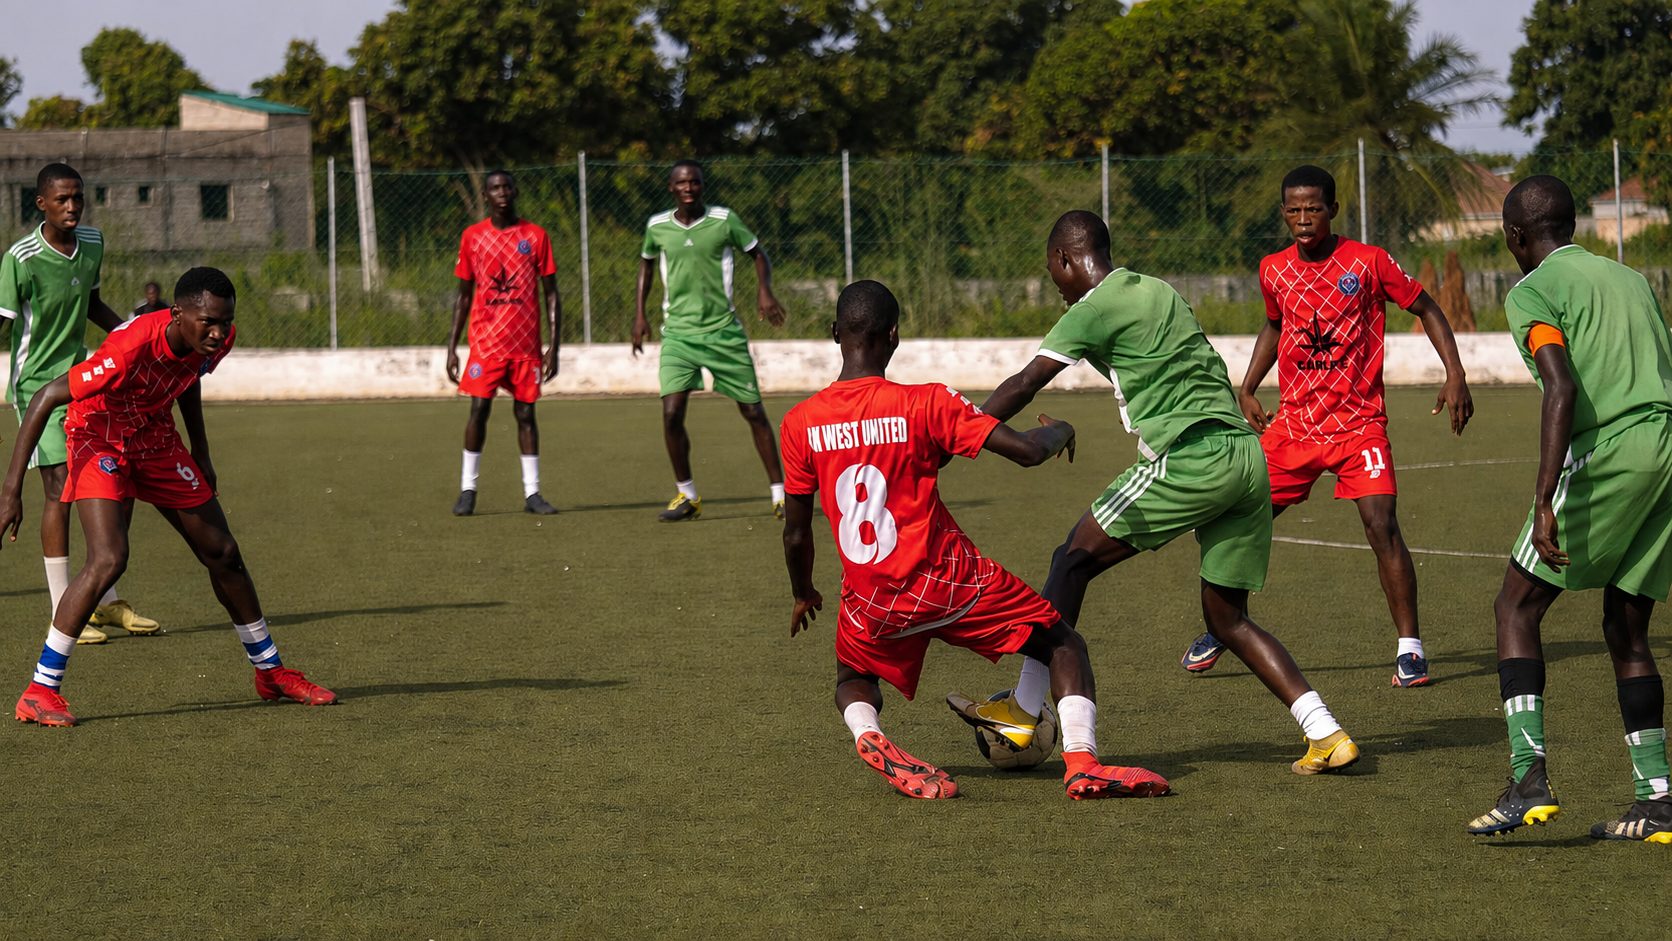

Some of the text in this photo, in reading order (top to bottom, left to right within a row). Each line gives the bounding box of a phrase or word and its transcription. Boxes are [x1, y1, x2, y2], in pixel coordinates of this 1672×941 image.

[821, 421, 859, 451] WEST
[861, 416, 908, 446] UNITED
[176, 462, 195, 481] 6
[1361, 446, 1386, 472] 11
[835, 463, 898, 565] 8
